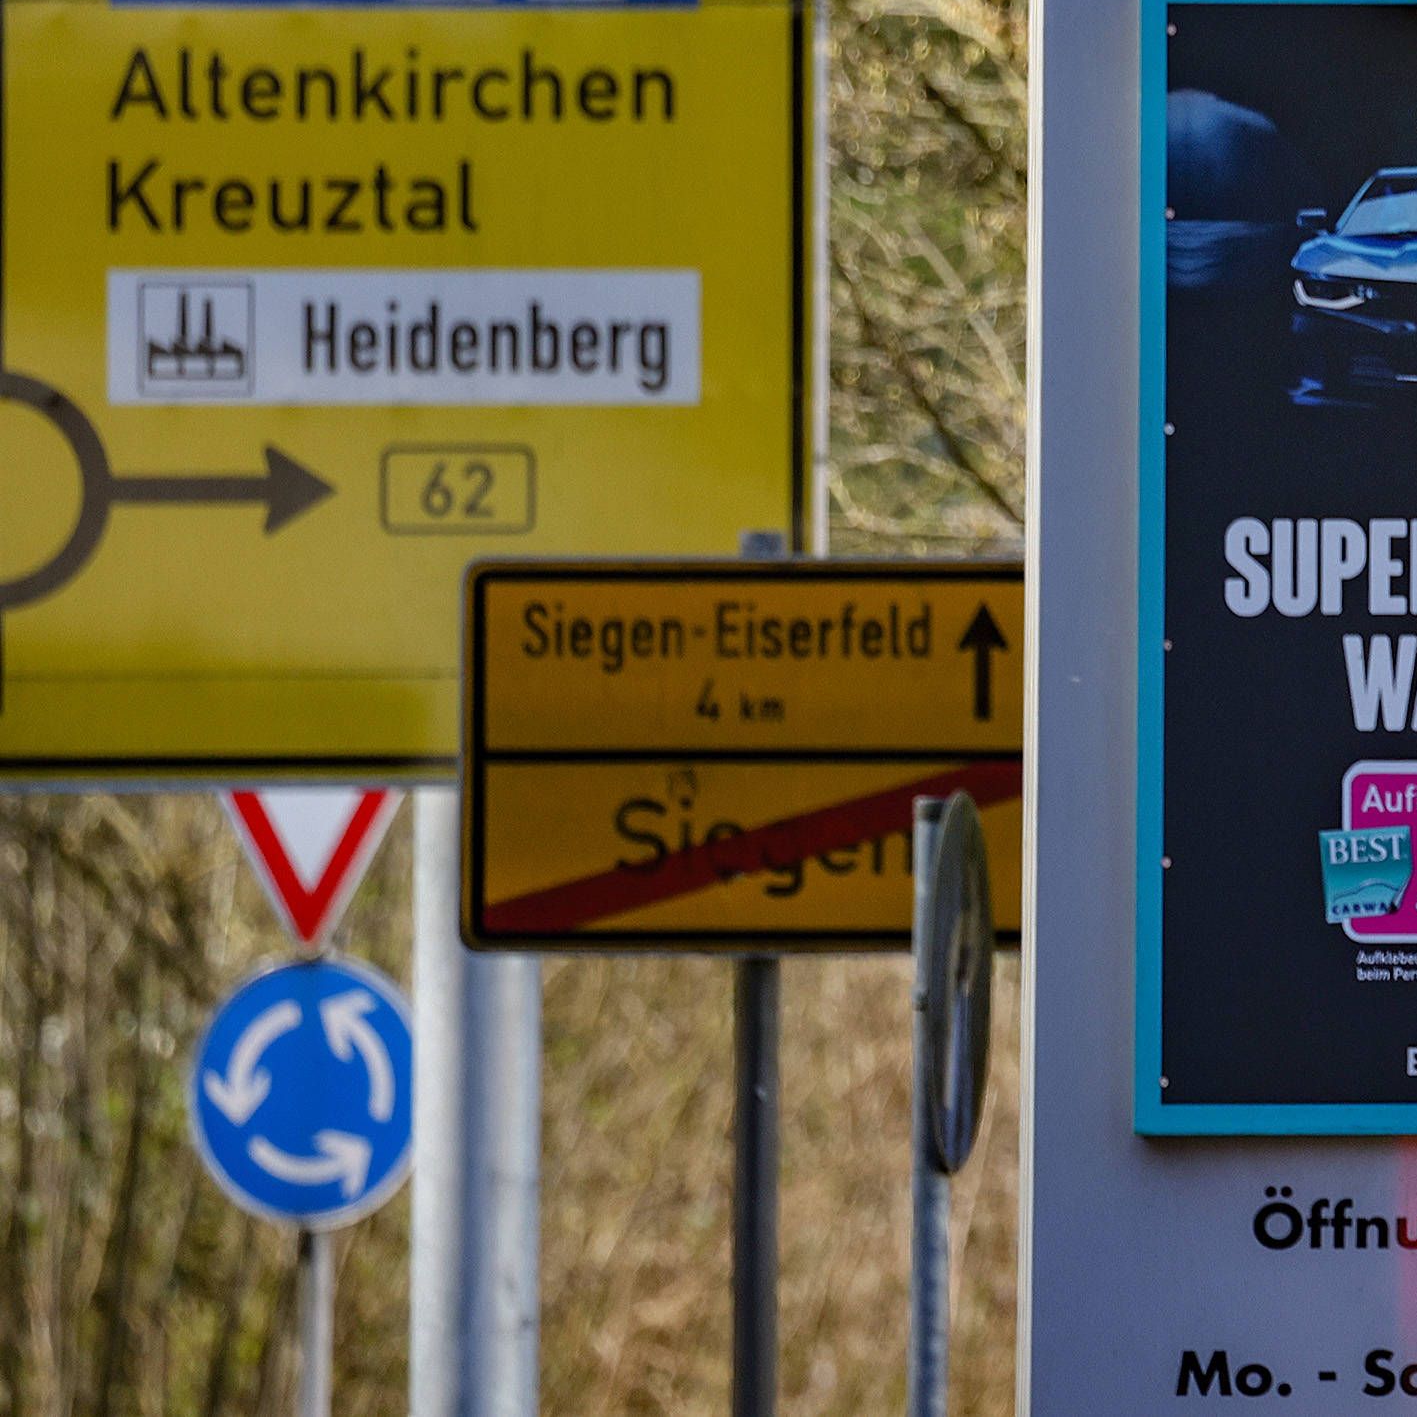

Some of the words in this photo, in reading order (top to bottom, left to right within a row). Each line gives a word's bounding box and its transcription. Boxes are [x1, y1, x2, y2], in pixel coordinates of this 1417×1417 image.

[109, 46, 677, 123] Altenkirchen
[106, 158, 479, 235] Kreuztal
[303, 299, 672, 394] Heidenberg
[419, 463, 496, 520] 62
[523, 602, 932, 674] Siegen-Eiserfeld
[694, 680, 721, 722] 4
[739, 691, 785, 722] km
[1328, 833, 1404, 865] BEST
[1356, 967, 1391, 981] beim
[1175, 1349, 1293, 1398] Mo.
